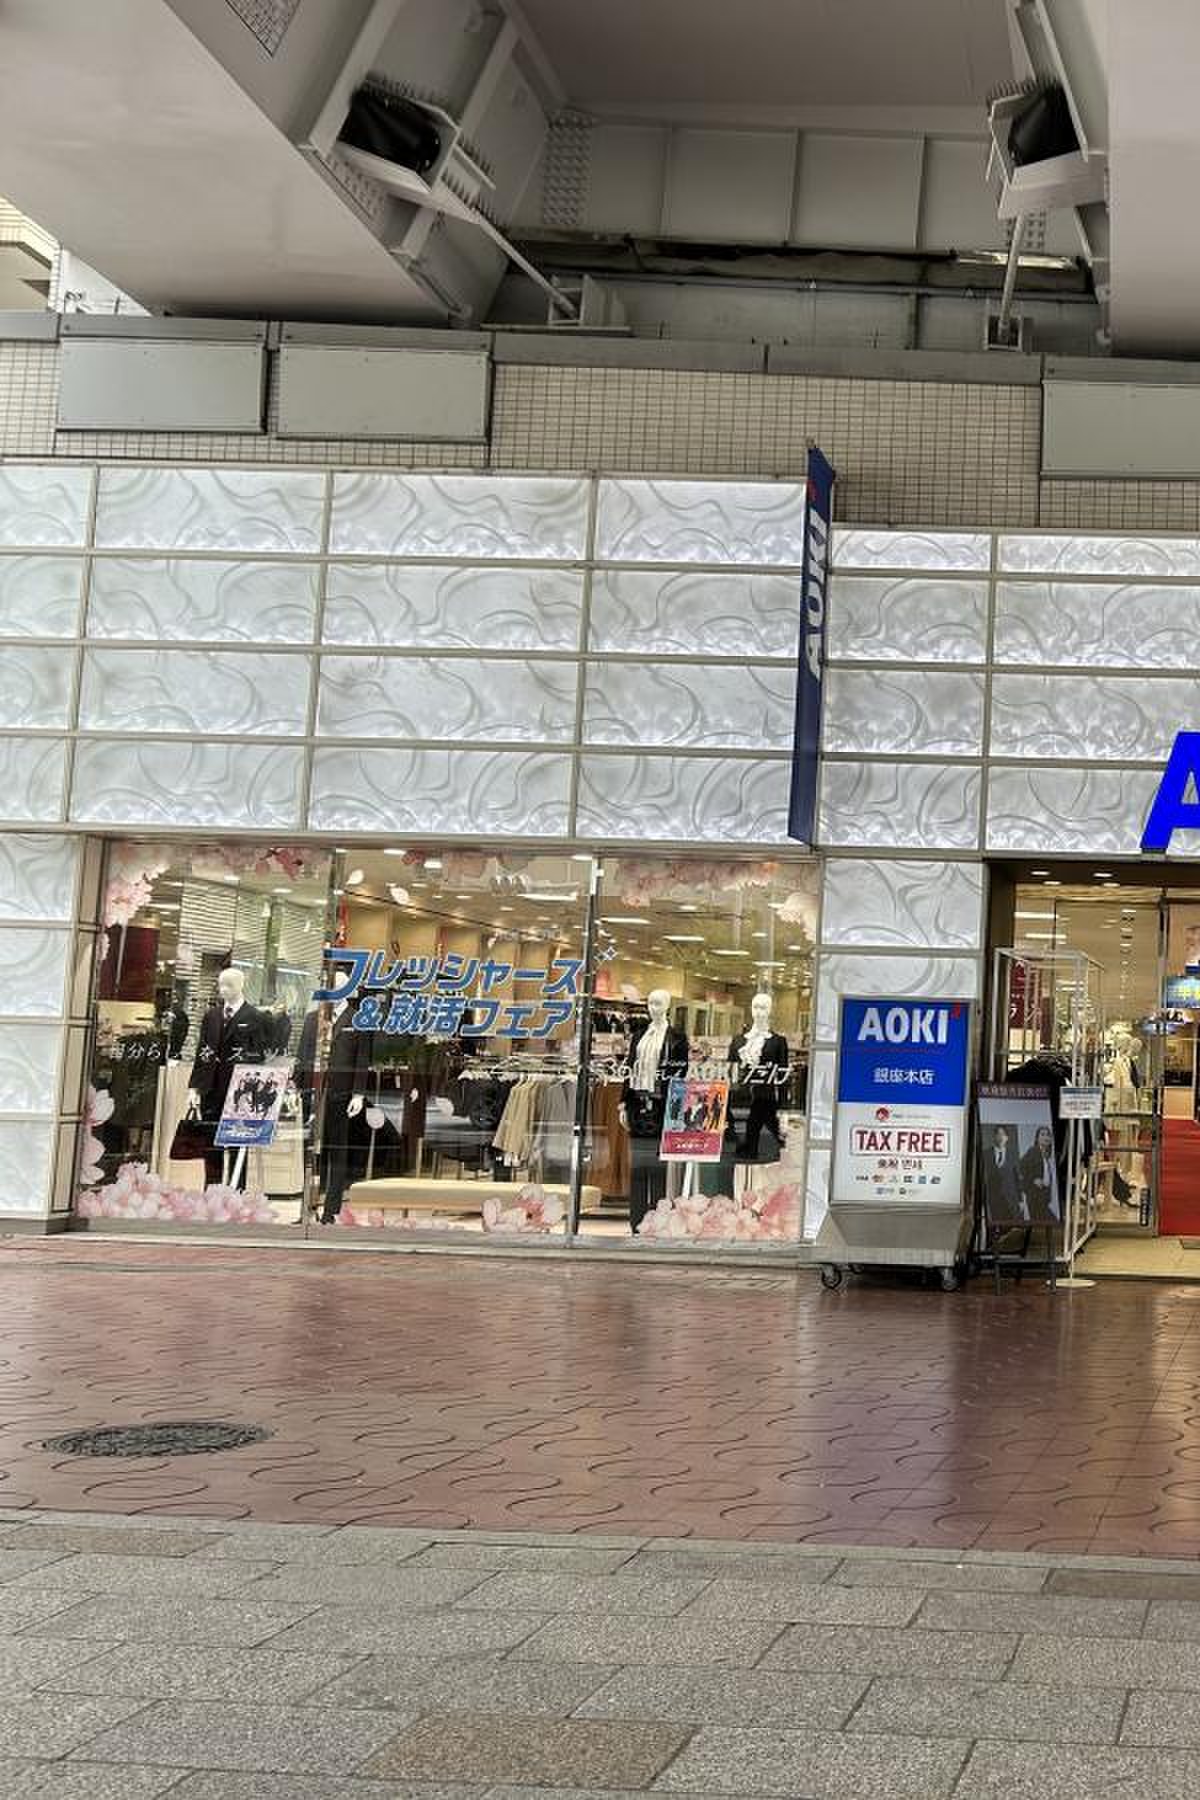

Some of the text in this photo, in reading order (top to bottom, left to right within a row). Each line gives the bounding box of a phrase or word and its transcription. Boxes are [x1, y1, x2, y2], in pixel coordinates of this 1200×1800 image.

[804, 507, 829, 684] AOKI
[857, 1007, 949, 1044] AOKI
[855, 1130, 945, 1153] TAX FREE
